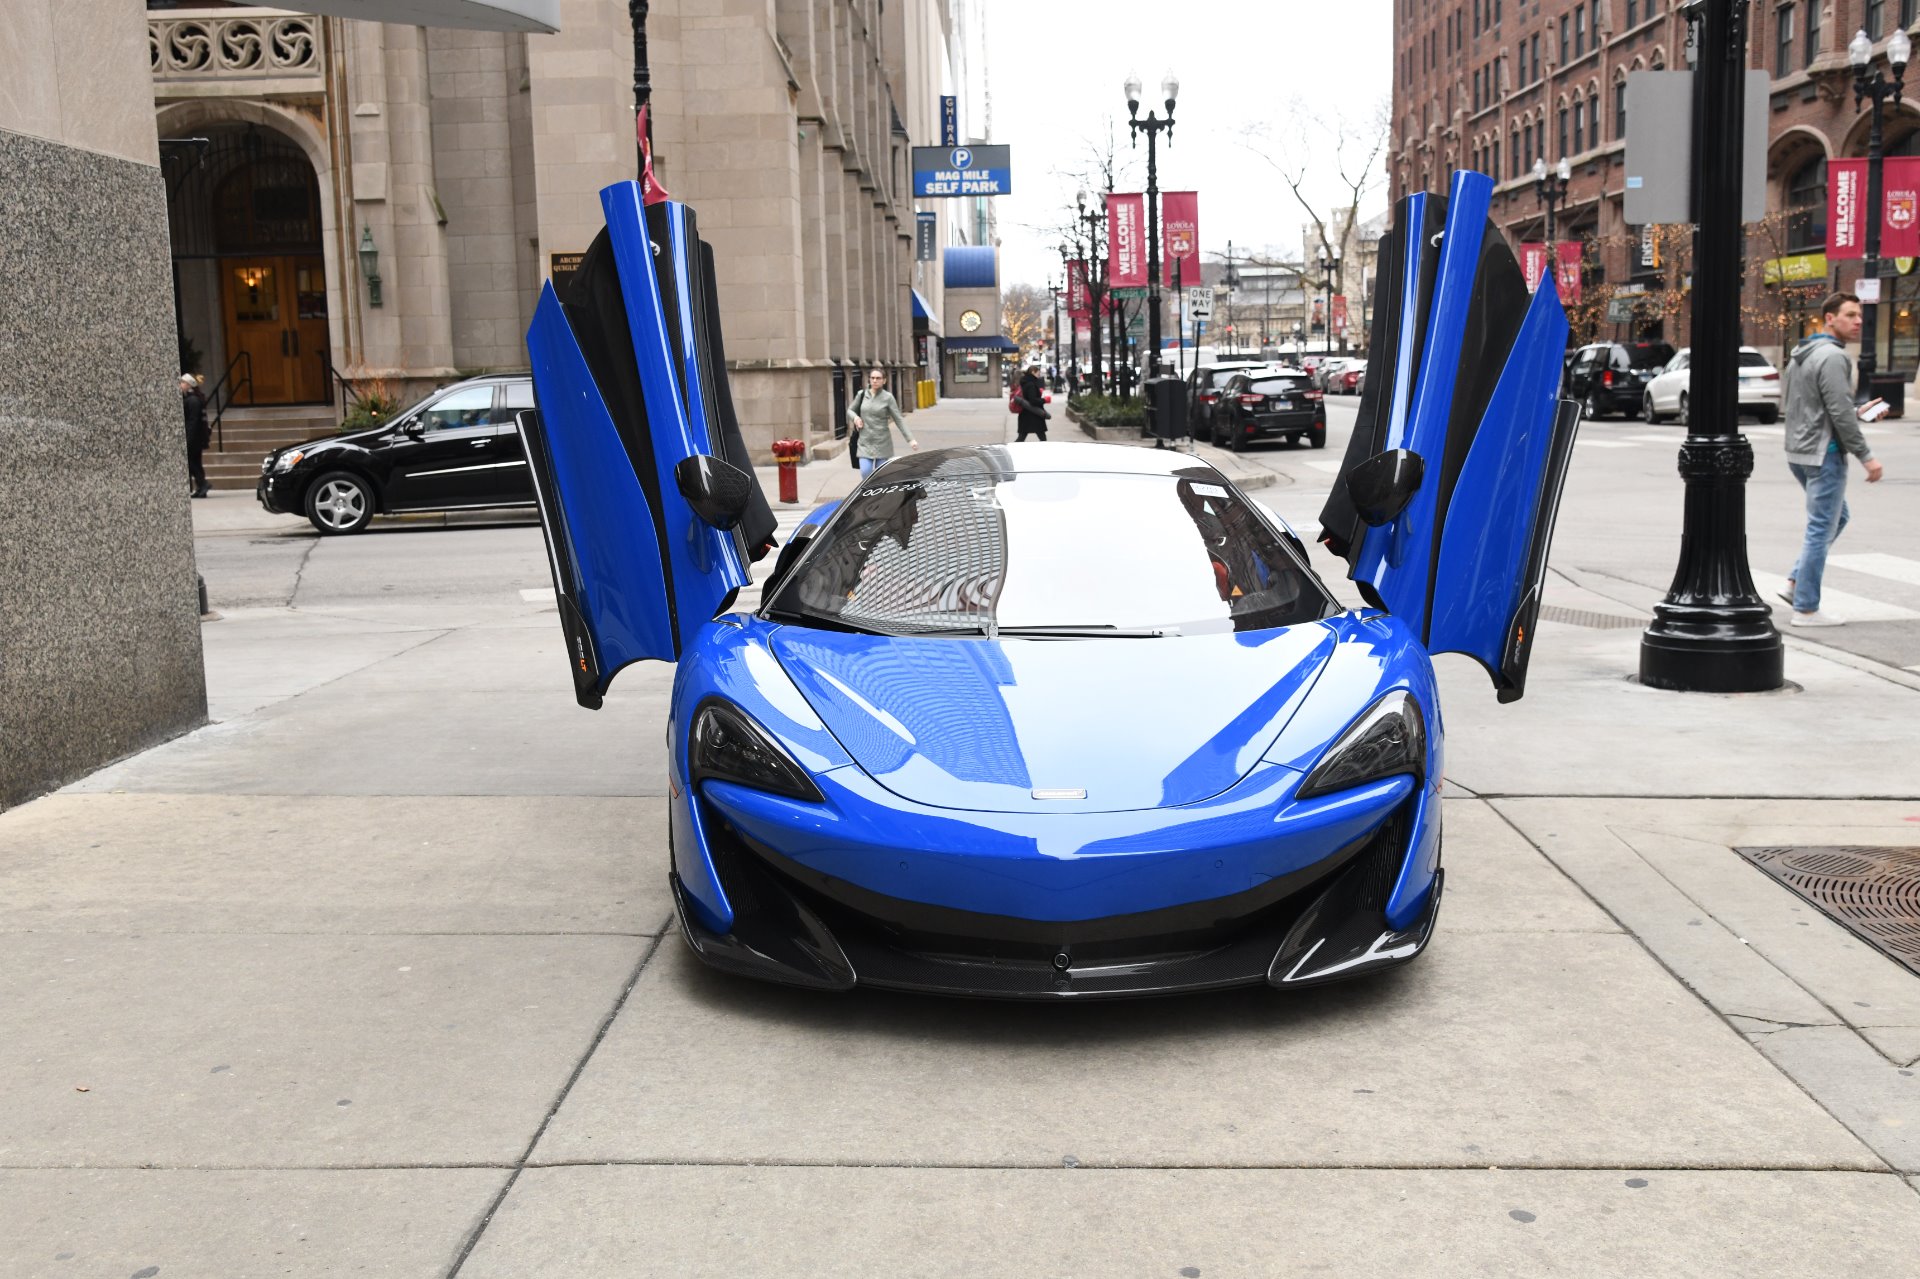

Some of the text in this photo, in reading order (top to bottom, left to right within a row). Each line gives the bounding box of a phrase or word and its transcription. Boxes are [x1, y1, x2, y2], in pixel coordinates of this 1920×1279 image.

[955, 150, 969, 166] P
[935, 169, 989, 181] MAG MILE
[925, 180, 999, 194] SELF PARK
[1837, 170, 1850, 247] WELCOME
[1166, 221, 1194, 229] LOYOLA
[1117, 203, 1131, 276] WELCOME
[1192, 289, 1211, 299] ONE
[1191, 300, 1211, 309] WAY
[946, 347, 1002, 355] GHIRARDELLI
